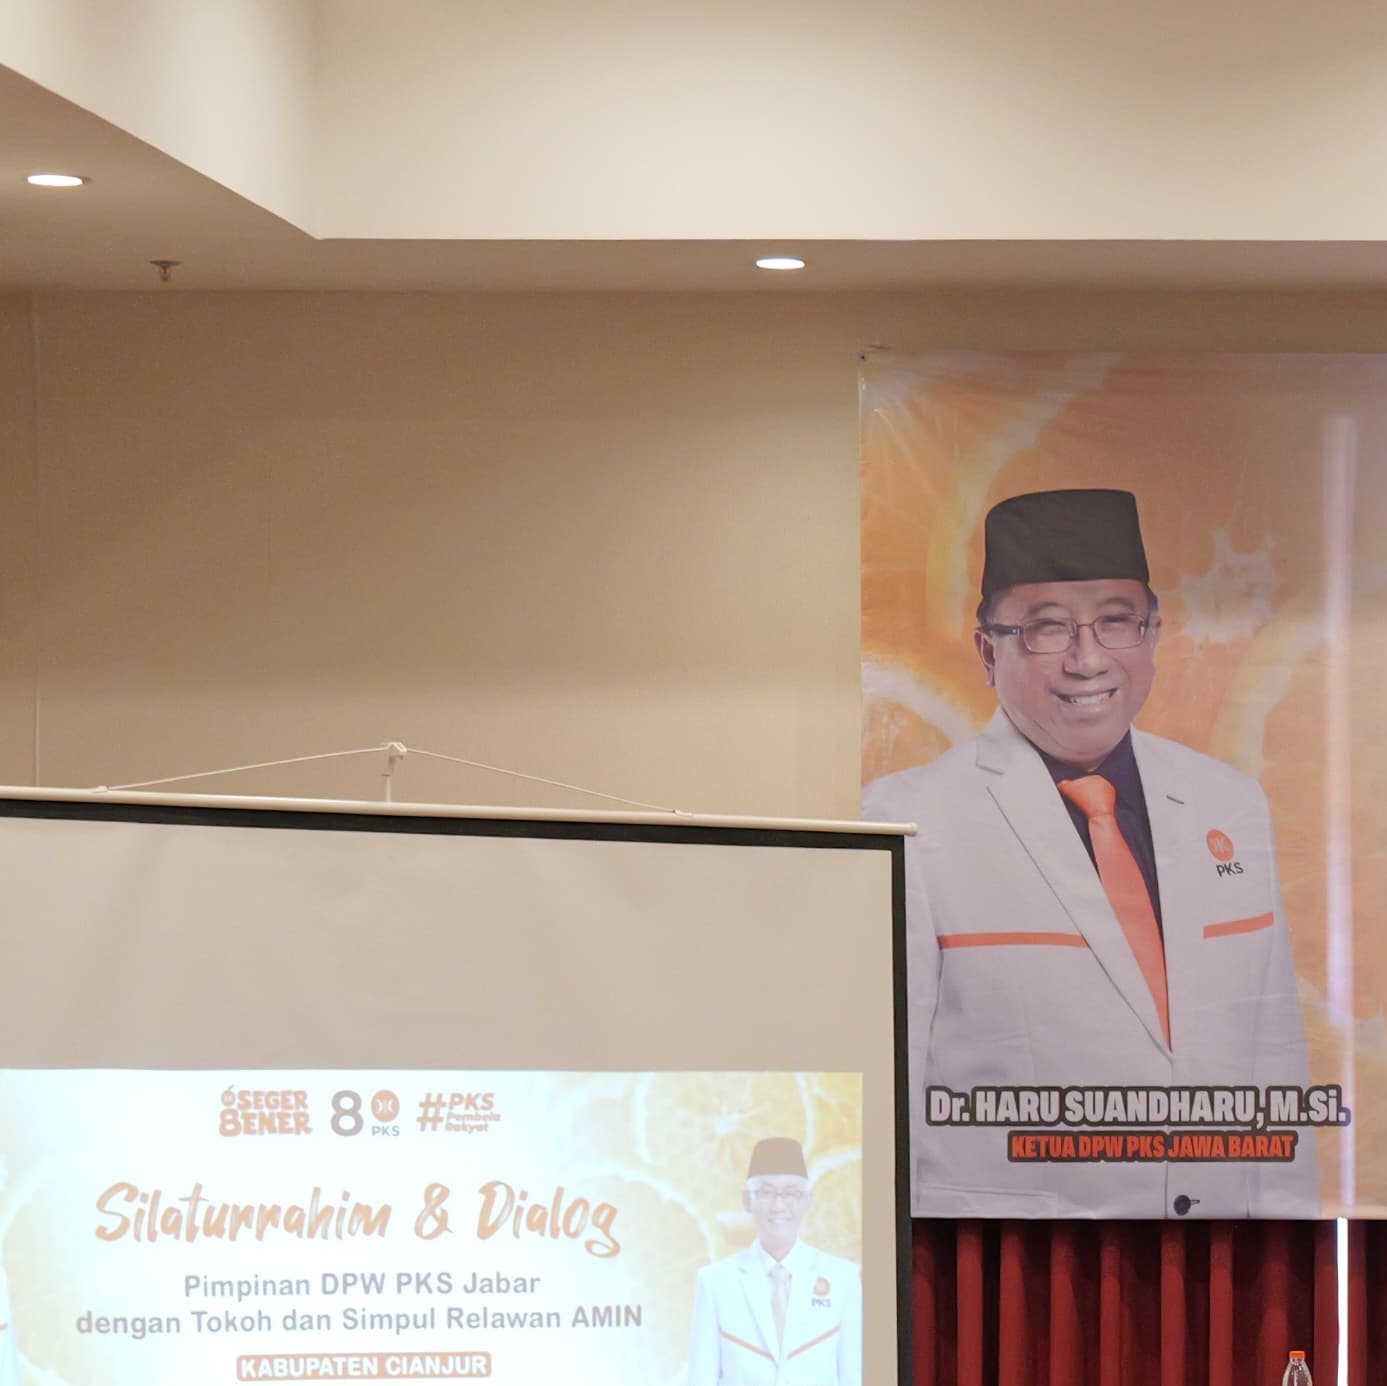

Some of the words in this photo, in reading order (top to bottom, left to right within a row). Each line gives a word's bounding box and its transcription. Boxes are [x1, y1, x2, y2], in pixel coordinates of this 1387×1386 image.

[1216, 862, 1244, 877] PKS
[237, 1090, 308, 1110] SEGER
[330, 1090, 364, 1137] 8
[929, 1090, 970, 1124] Dr.
[975, 1090, 1060, 1123] HARU
[1064, 1090, 1265, 1131] SUANDHARU,
[1270, 1088, 1348, 1124] M.Si.
[371, 1125, 400, 1137] PKS
[1011, 1136, 1076, 1158] KETUA
[1078, 1136, 1123, 1158] DPW
[1127, 1135, 1165, 1158] PKS
[1167, 1135, 1227, 1158] JAWA
[1229, 1135, 1295, 1157] BARAT
[95, 1181, 391, 1243] Silaturrahim
[414, 1183, 452, 1240] &
[477, 1179, 621, 1259] Dialog
[184, 1272, 310, 1300] Pimpinan
[321, 1273, 386, 1296] DPW
[396, 1271, 453, 1294] PKS
[463, 1270, 540, 1294] Jabar
[76, 1310, 181, 1338] dengan
[191, 1309, 272, 1332] Tokoh
[282, 1308, 332, 1331] dan
[341, 1307, 437, 1336] Simpul
[446, 1305, 562, 1329] Relawan
[571, 1304, 643, 1328] AMIN
[241, 1355, 378, 1379] KABUPATEN
[386, 1354, 487, 1377] CIANJUR
